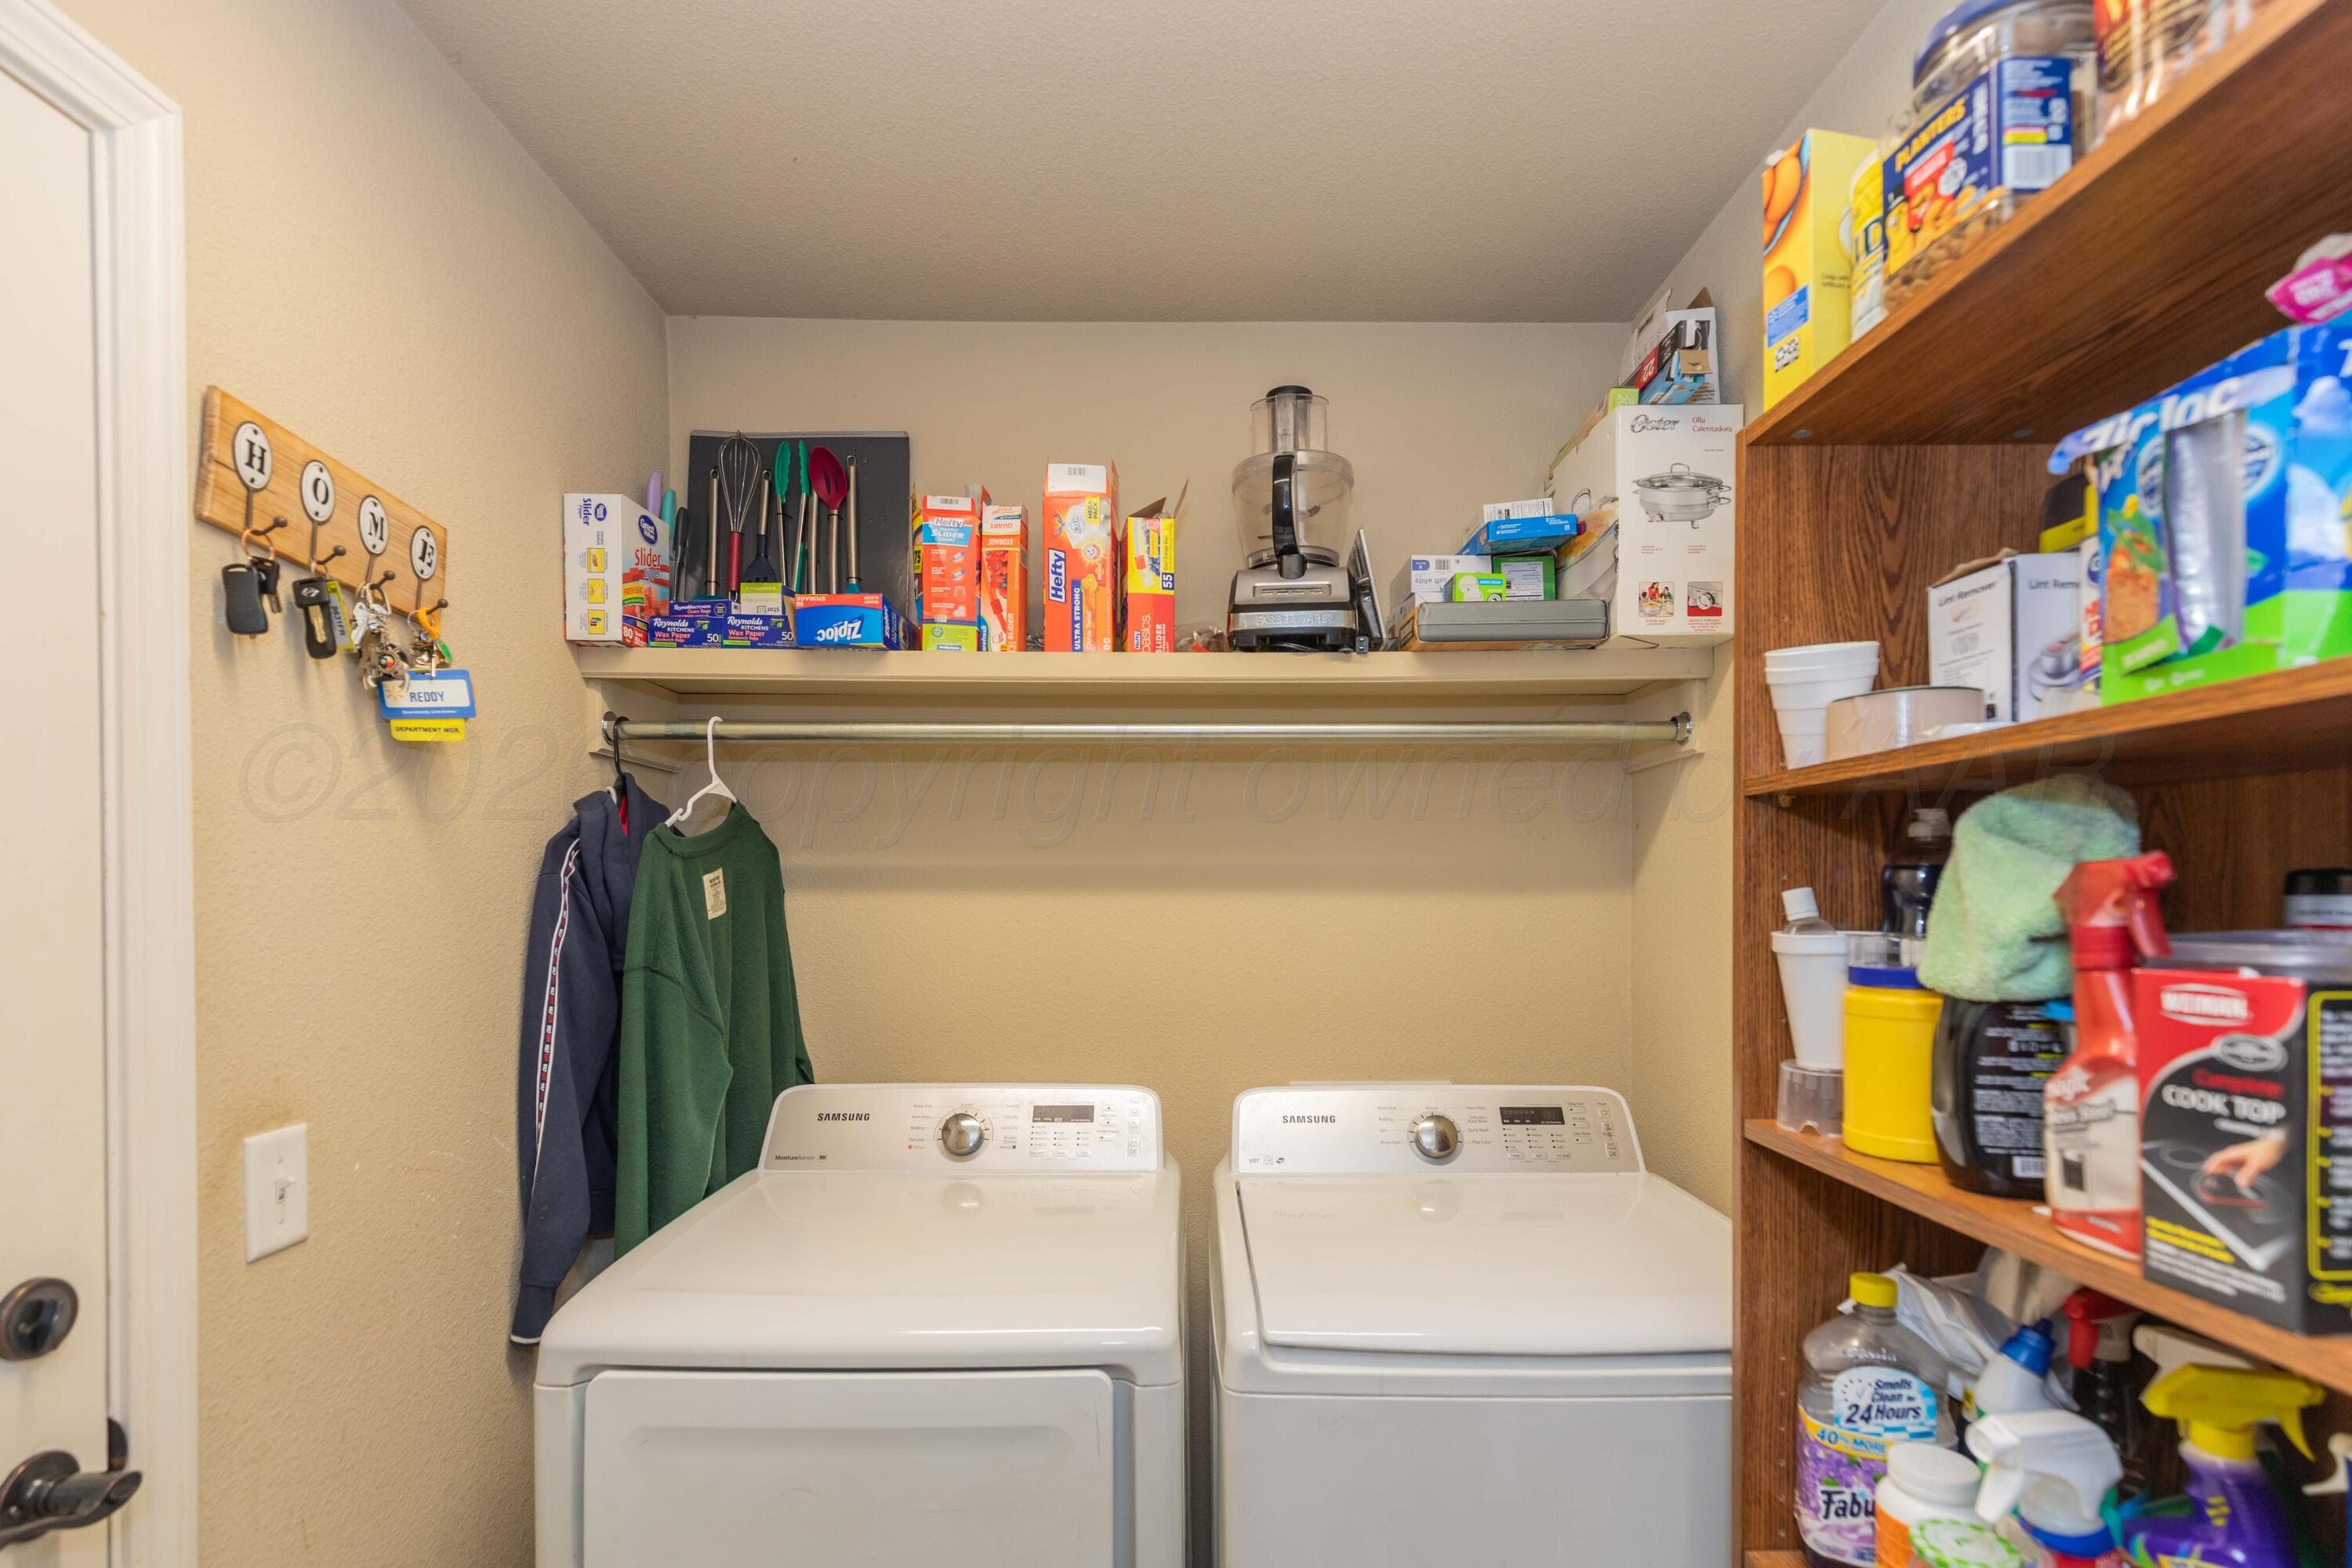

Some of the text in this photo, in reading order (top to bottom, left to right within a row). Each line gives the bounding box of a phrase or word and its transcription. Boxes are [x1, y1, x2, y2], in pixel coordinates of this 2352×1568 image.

[1631, 414, 1680, 433] Oster
[583, 498, 592, 526] Slider
[935, 517, 964, 528] Hefty
[931, 528, 964, 539] SLIDER
[634, 546, 662, 568] Slider
[644, 568, 660, 579] Zipper
[1051, 553, 1065, 600] Hefty
[1163, 574, 1173, 589] 55
[2029, 579, 2049, 589] Lint
[1957, 581, 1997, 600] Remover
[653, 617, 689, 628] Reynolds
[727, 616, 763, 626] Reynolds
[1254, 615, 1330, 626] FARBERWARE
[622, 626, 633, 639] 80
[781, 631, 793, 641] 50
[817, 619, 862, 642] Ziploc
[706, 633, 719, 642] 50
[409, 691, 445, 702] REDDY
[2161, 1083, 2287, 1125] COOK TOP
[817, 1112, 870, 1121] SAMSUNG
[1283, 1115, 1336, 1123] SAMSUNG
[1875, 1378, 1913, 1390] Smells
[1872, 1392, 1904, 1403] Clean
[1845, 1403, 1922, 1425] 24 Hours
[1820, 1490, 1875, 1520] Fabu
